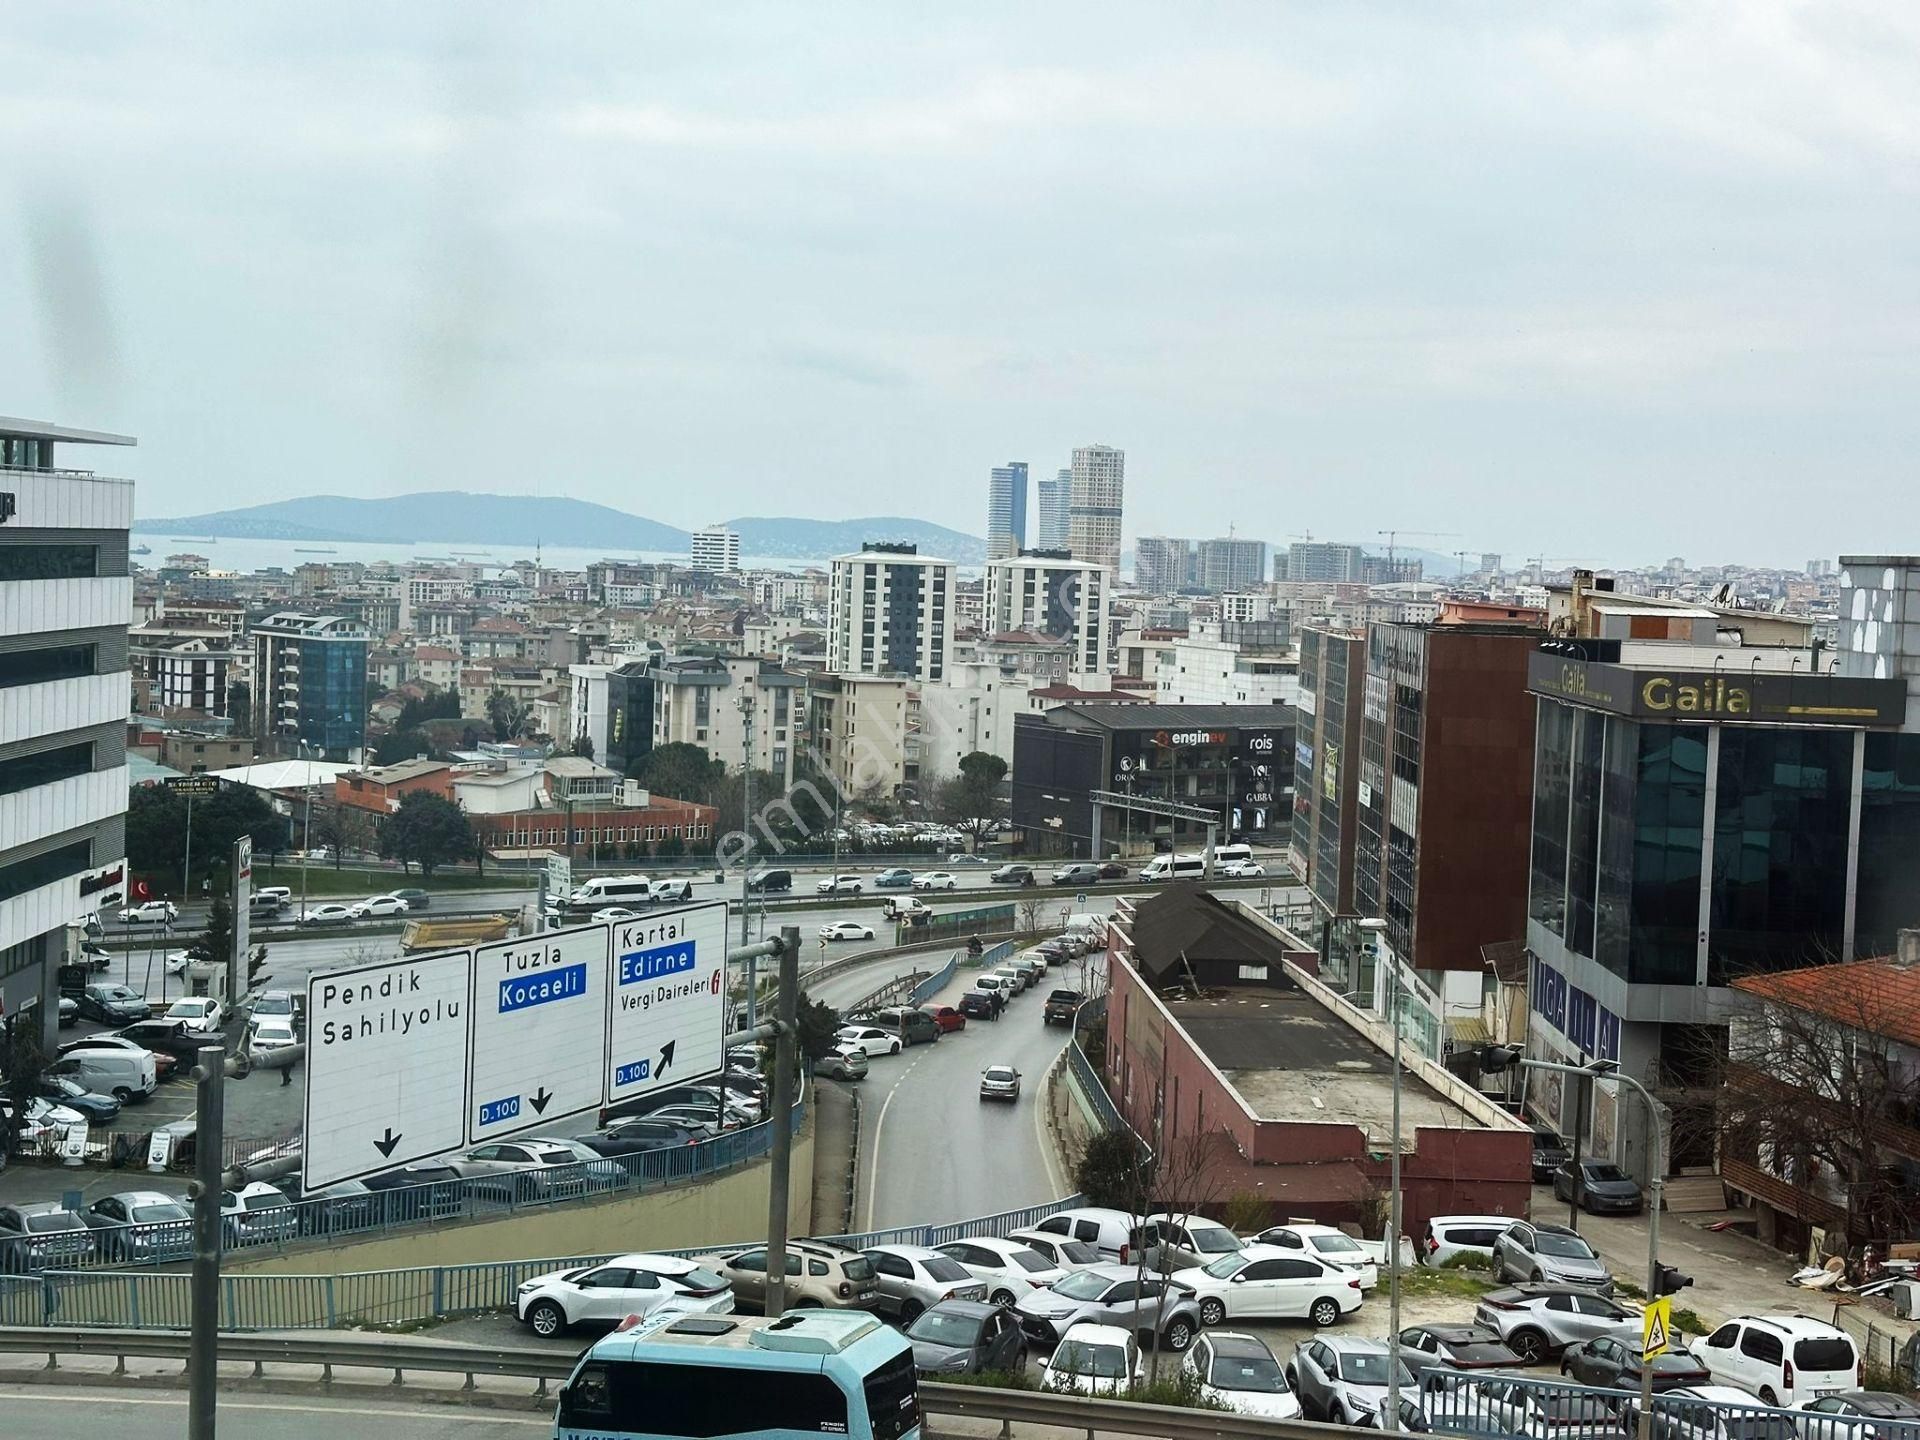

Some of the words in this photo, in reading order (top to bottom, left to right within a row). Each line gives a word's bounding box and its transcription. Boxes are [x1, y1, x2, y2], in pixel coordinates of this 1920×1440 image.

[1642, 677, 1750, 713] Gaila
[1171, 730, 1227, 745] enginev
[1249, 733, 1273, 750] rois
[622, 917, 685, 949] Kartal
[503, 944, 561, 973] Tuzla
[621, 951, 688, 980] Edirne
[323, 969, 421, 1009] Pendik
[501, 971, 577, 1007] Kocaeli
[621, 990, 654, 1011] Vergi
[657, 976, 710, 1003] Daireleri
[323, 999, 459, 1045] Sahilyolu
